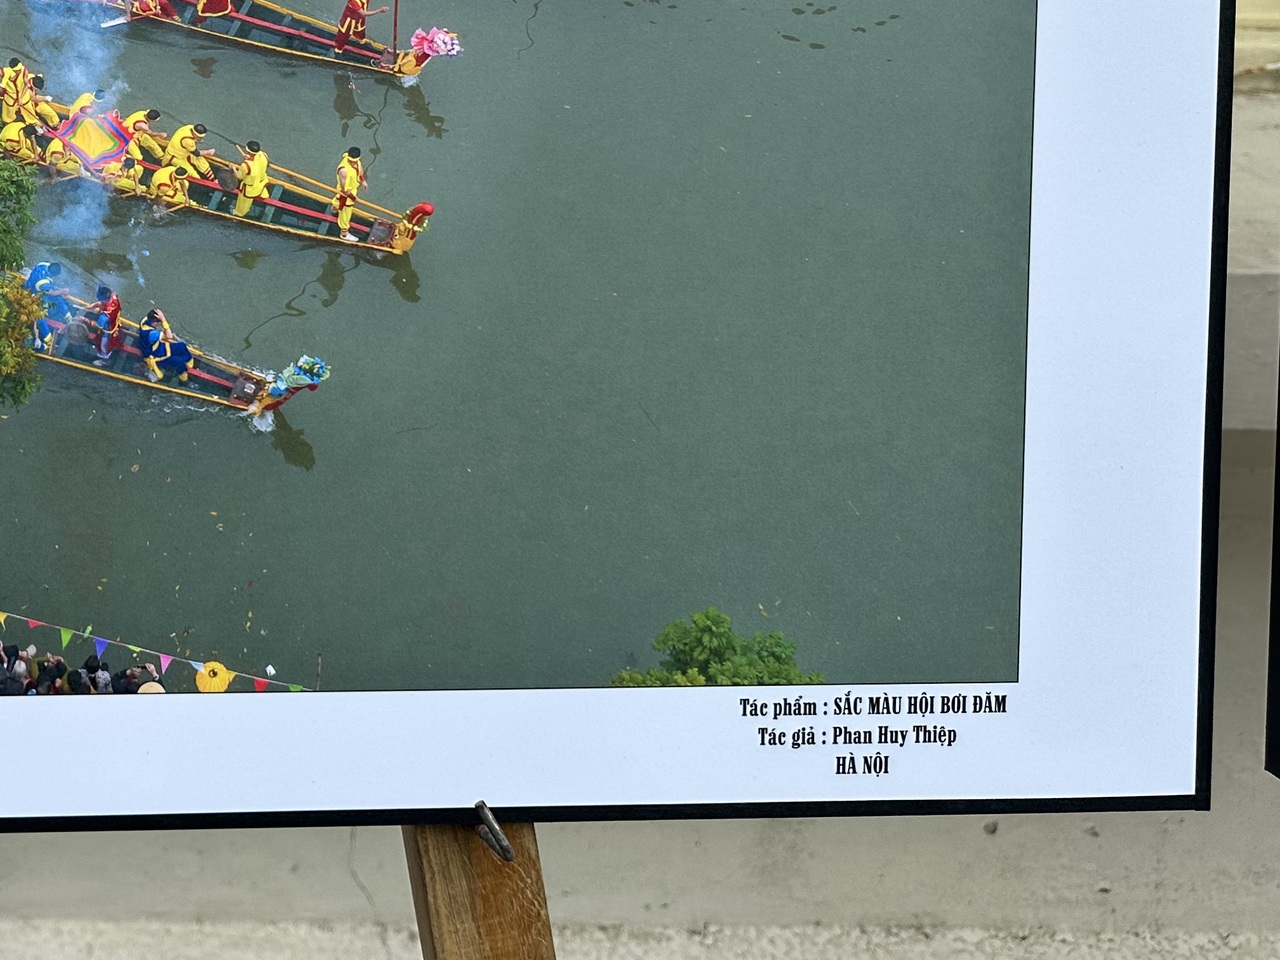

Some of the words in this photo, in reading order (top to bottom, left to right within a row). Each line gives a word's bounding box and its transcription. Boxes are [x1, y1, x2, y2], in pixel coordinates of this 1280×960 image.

[739, 698, 768, 717] Tác
[773, 695, 818, 720] phẩm
[833, 691, 863, 716] SẮC
[868, 693, 902, 715] MÀU
[907, 692, 935, 718] HỘI
[940, 694, 968, 714] BƠI
[972, 692, 1008, 714] ĐĂM
[758, 727, 786, 746] Tác
[791, 727, 816, 750] giả
[832, 726, 873, 745] Phan
[878, 726, 908, 748] Huy
[913, 725, 957, 747] Thiệp
[835, 752, 858, 775] HÀ
[863, 752, 890, 778] NỘI
